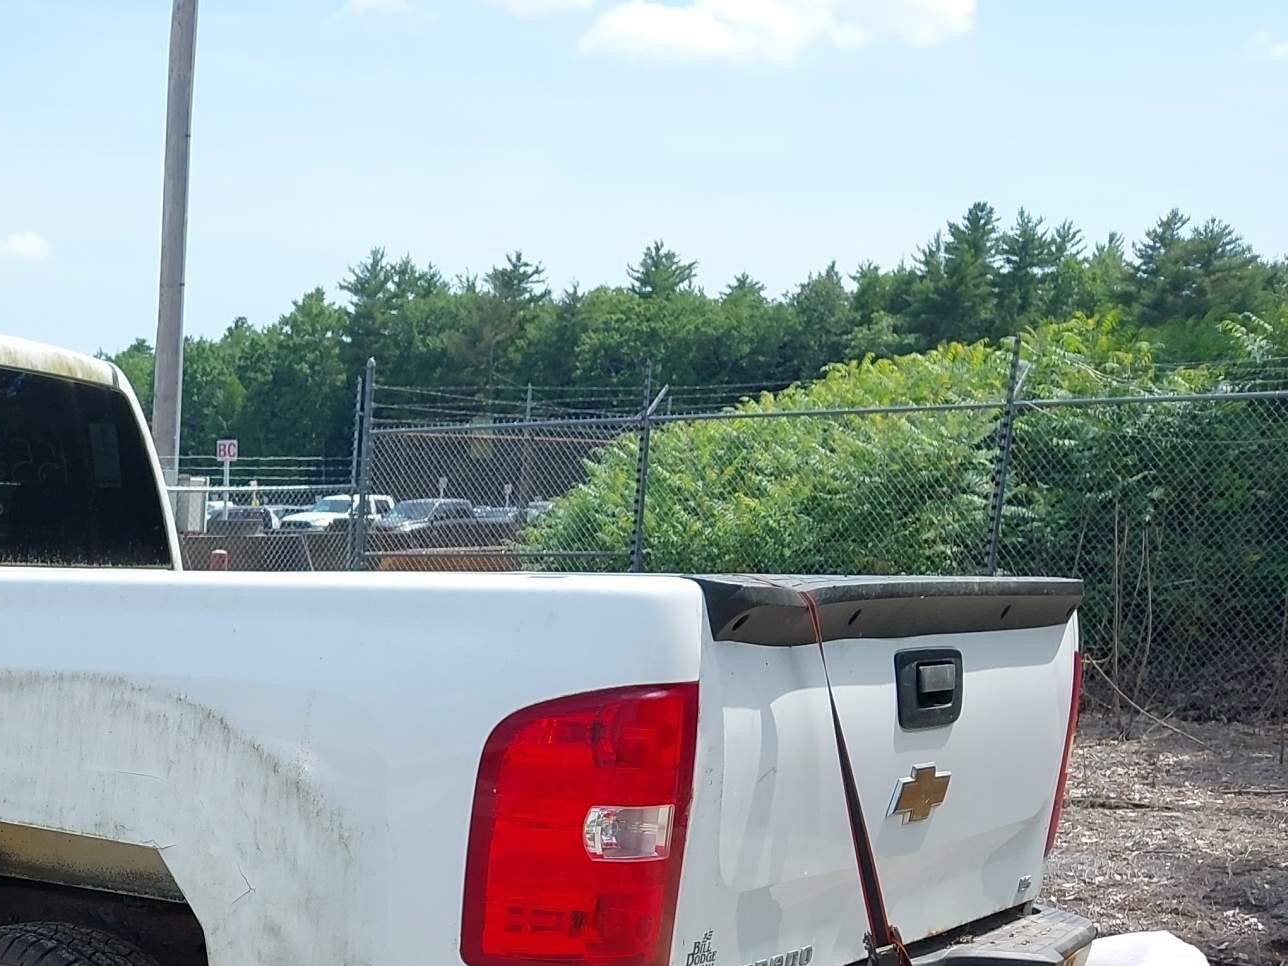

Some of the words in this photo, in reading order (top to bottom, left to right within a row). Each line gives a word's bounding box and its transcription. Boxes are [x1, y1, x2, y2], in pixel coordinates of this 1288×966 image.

[219, 443, 236, 457] BC
[693, 941, 711, 955] BILL
[686, 951, 717, 966] DODGE
